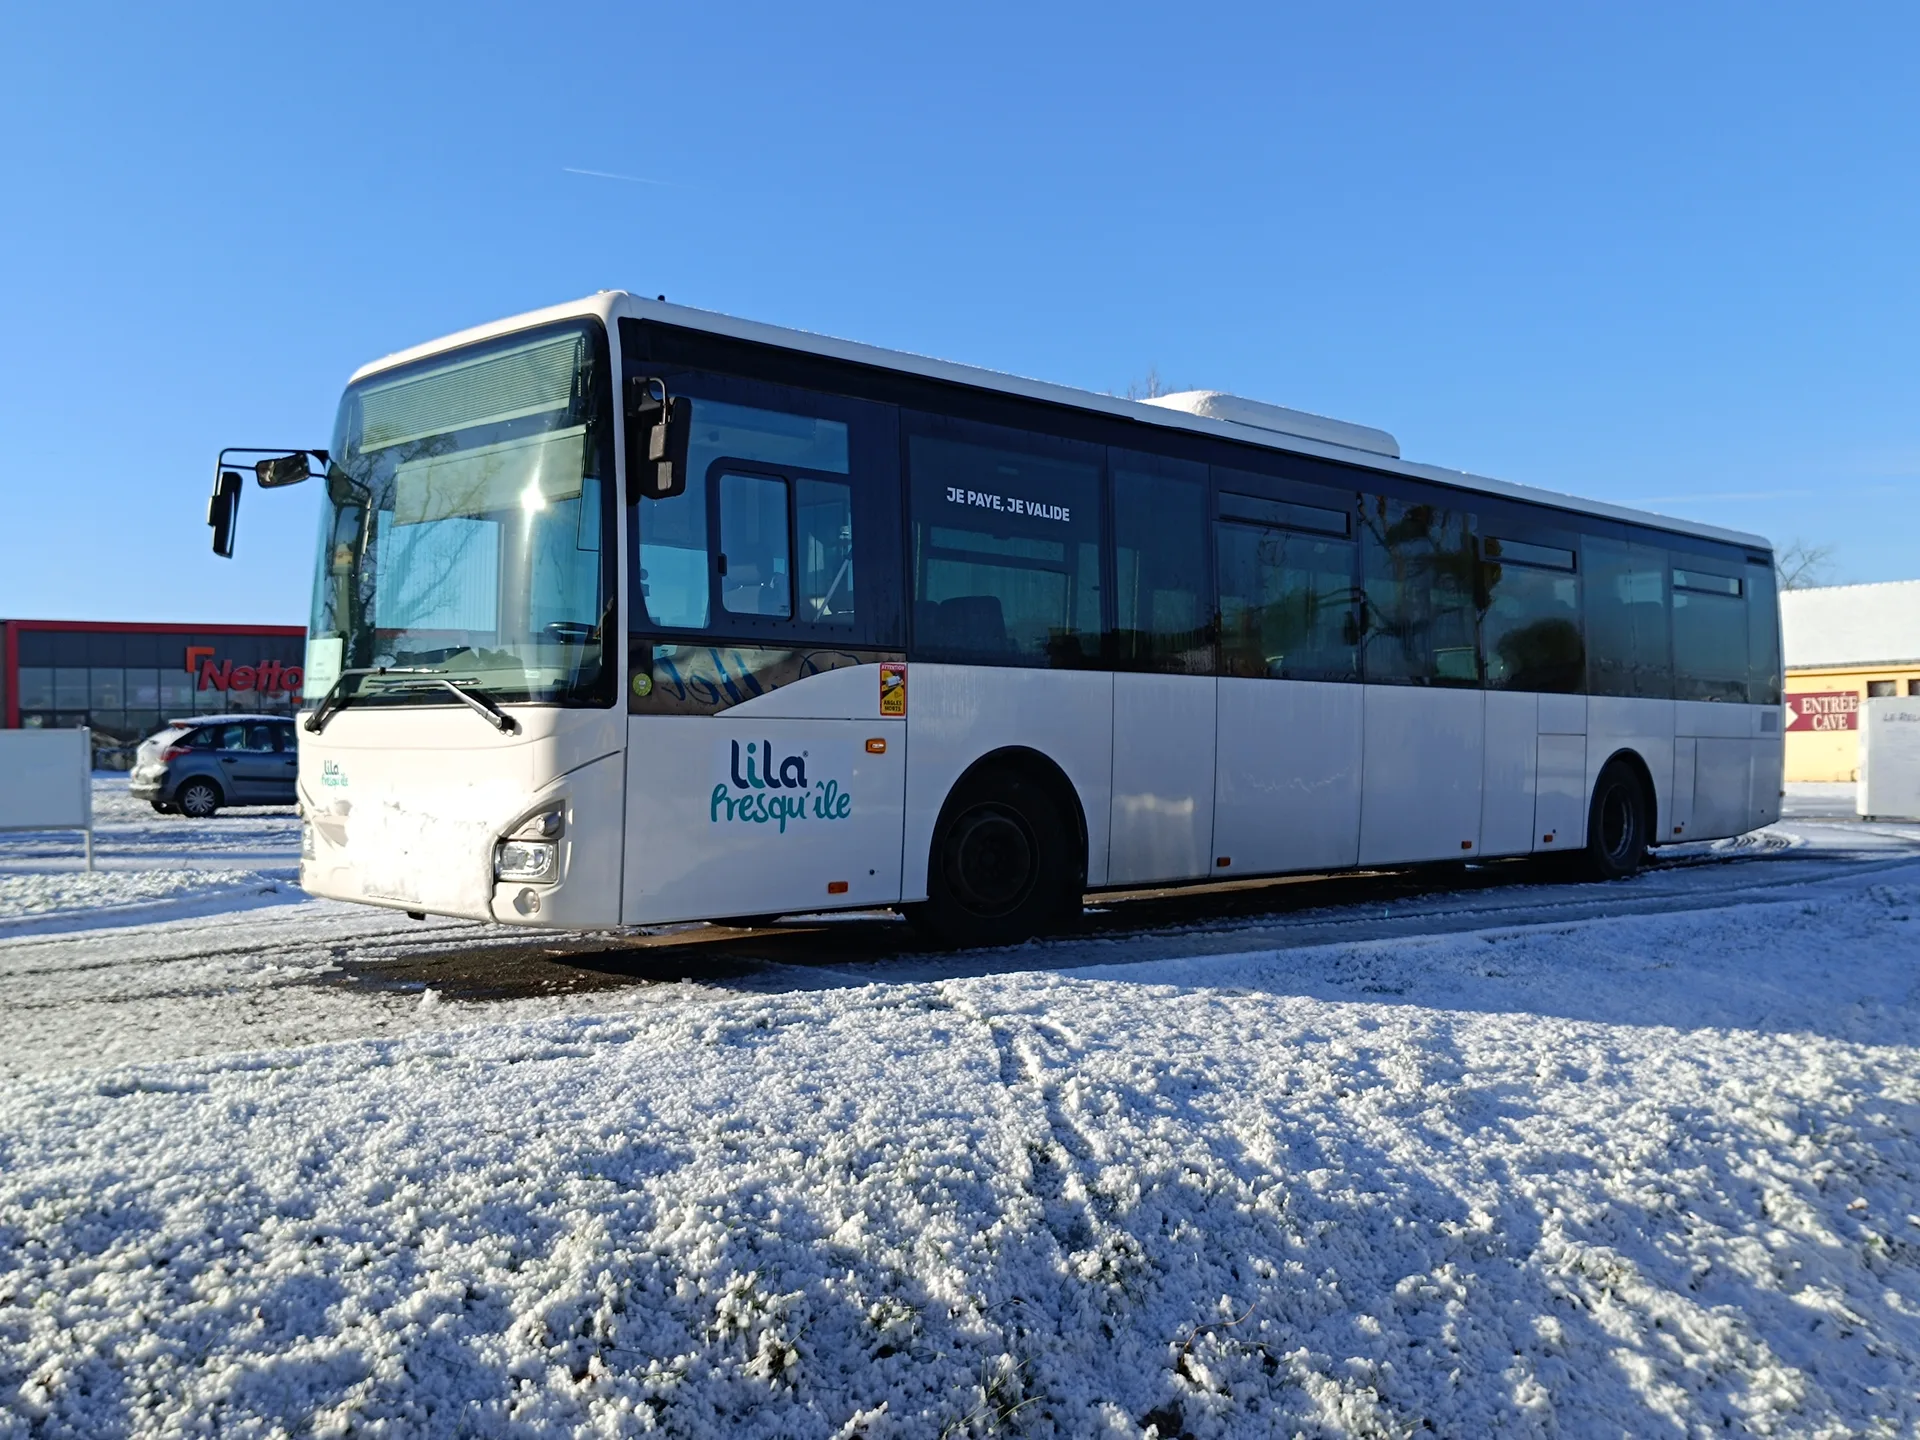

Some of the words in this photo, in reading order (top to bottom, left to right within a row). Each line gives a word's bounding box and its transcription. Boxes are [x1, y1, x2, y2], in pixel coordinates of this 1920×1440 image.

[946, 486, 965, 504] JE
[967, 490, 1005, 512] PAYE,
[1006, 497, 1025, 515] JE
[1025, 501, 1070, 522] VALIDE
[197, 659, 305, 692] Netto
[881, 663, 905, 671] ATTENTION
[1801, 692, 1858, 714] ENTRÉE
[1813, 713, 1848, 731] CAVE
